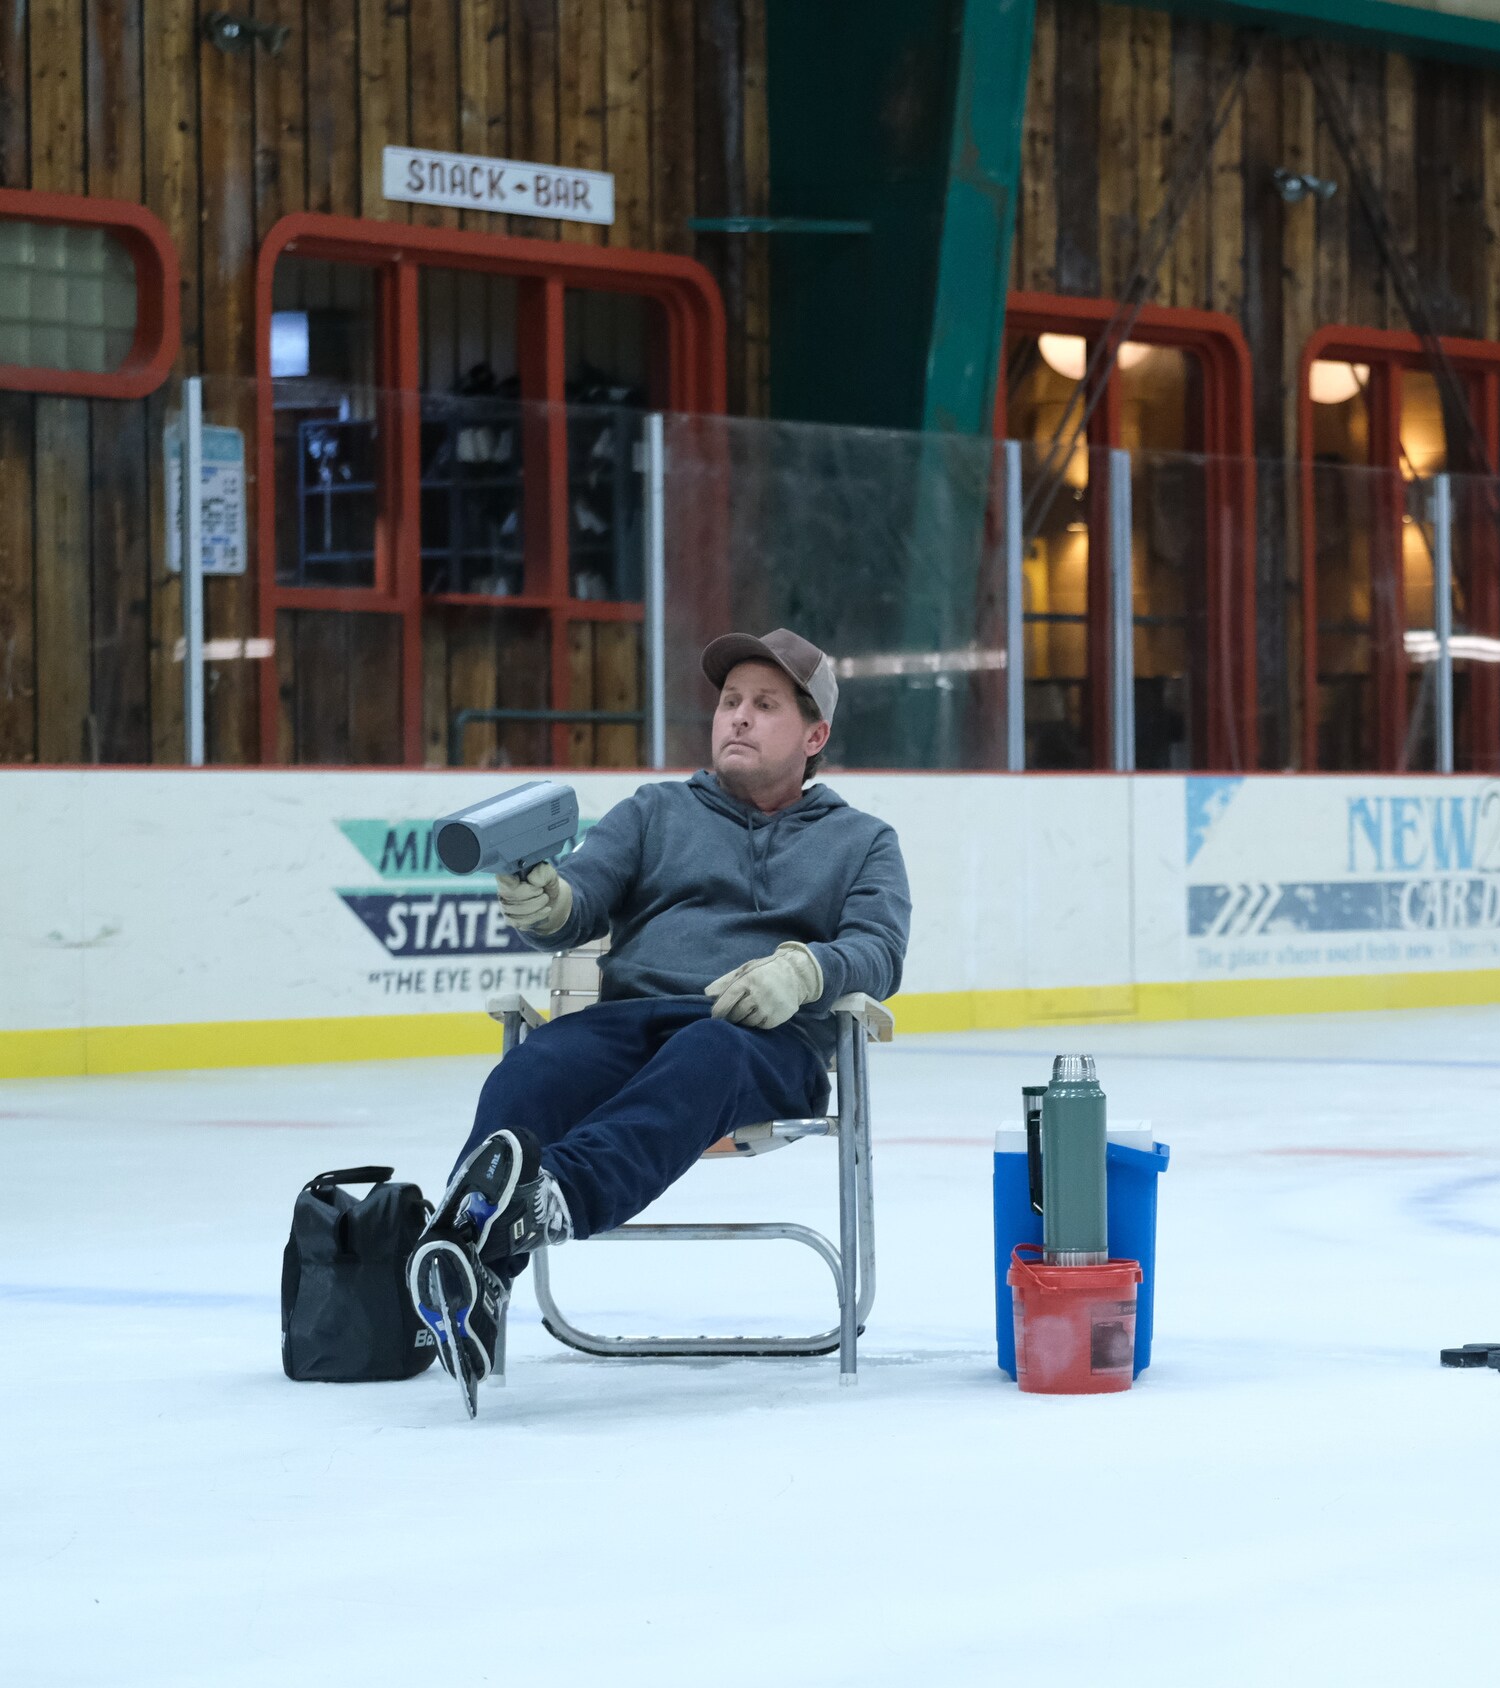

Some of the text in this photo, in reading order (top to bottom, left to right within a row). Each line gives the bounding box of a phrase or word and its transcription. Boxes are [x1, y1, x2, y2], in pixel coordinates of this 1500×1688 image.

[384, 900, 511, 950] STATE
[1401, 879, 1470, 931] CAR
[434, 968, 471, 994] EYE
[479, 967, 505, 991] OF
